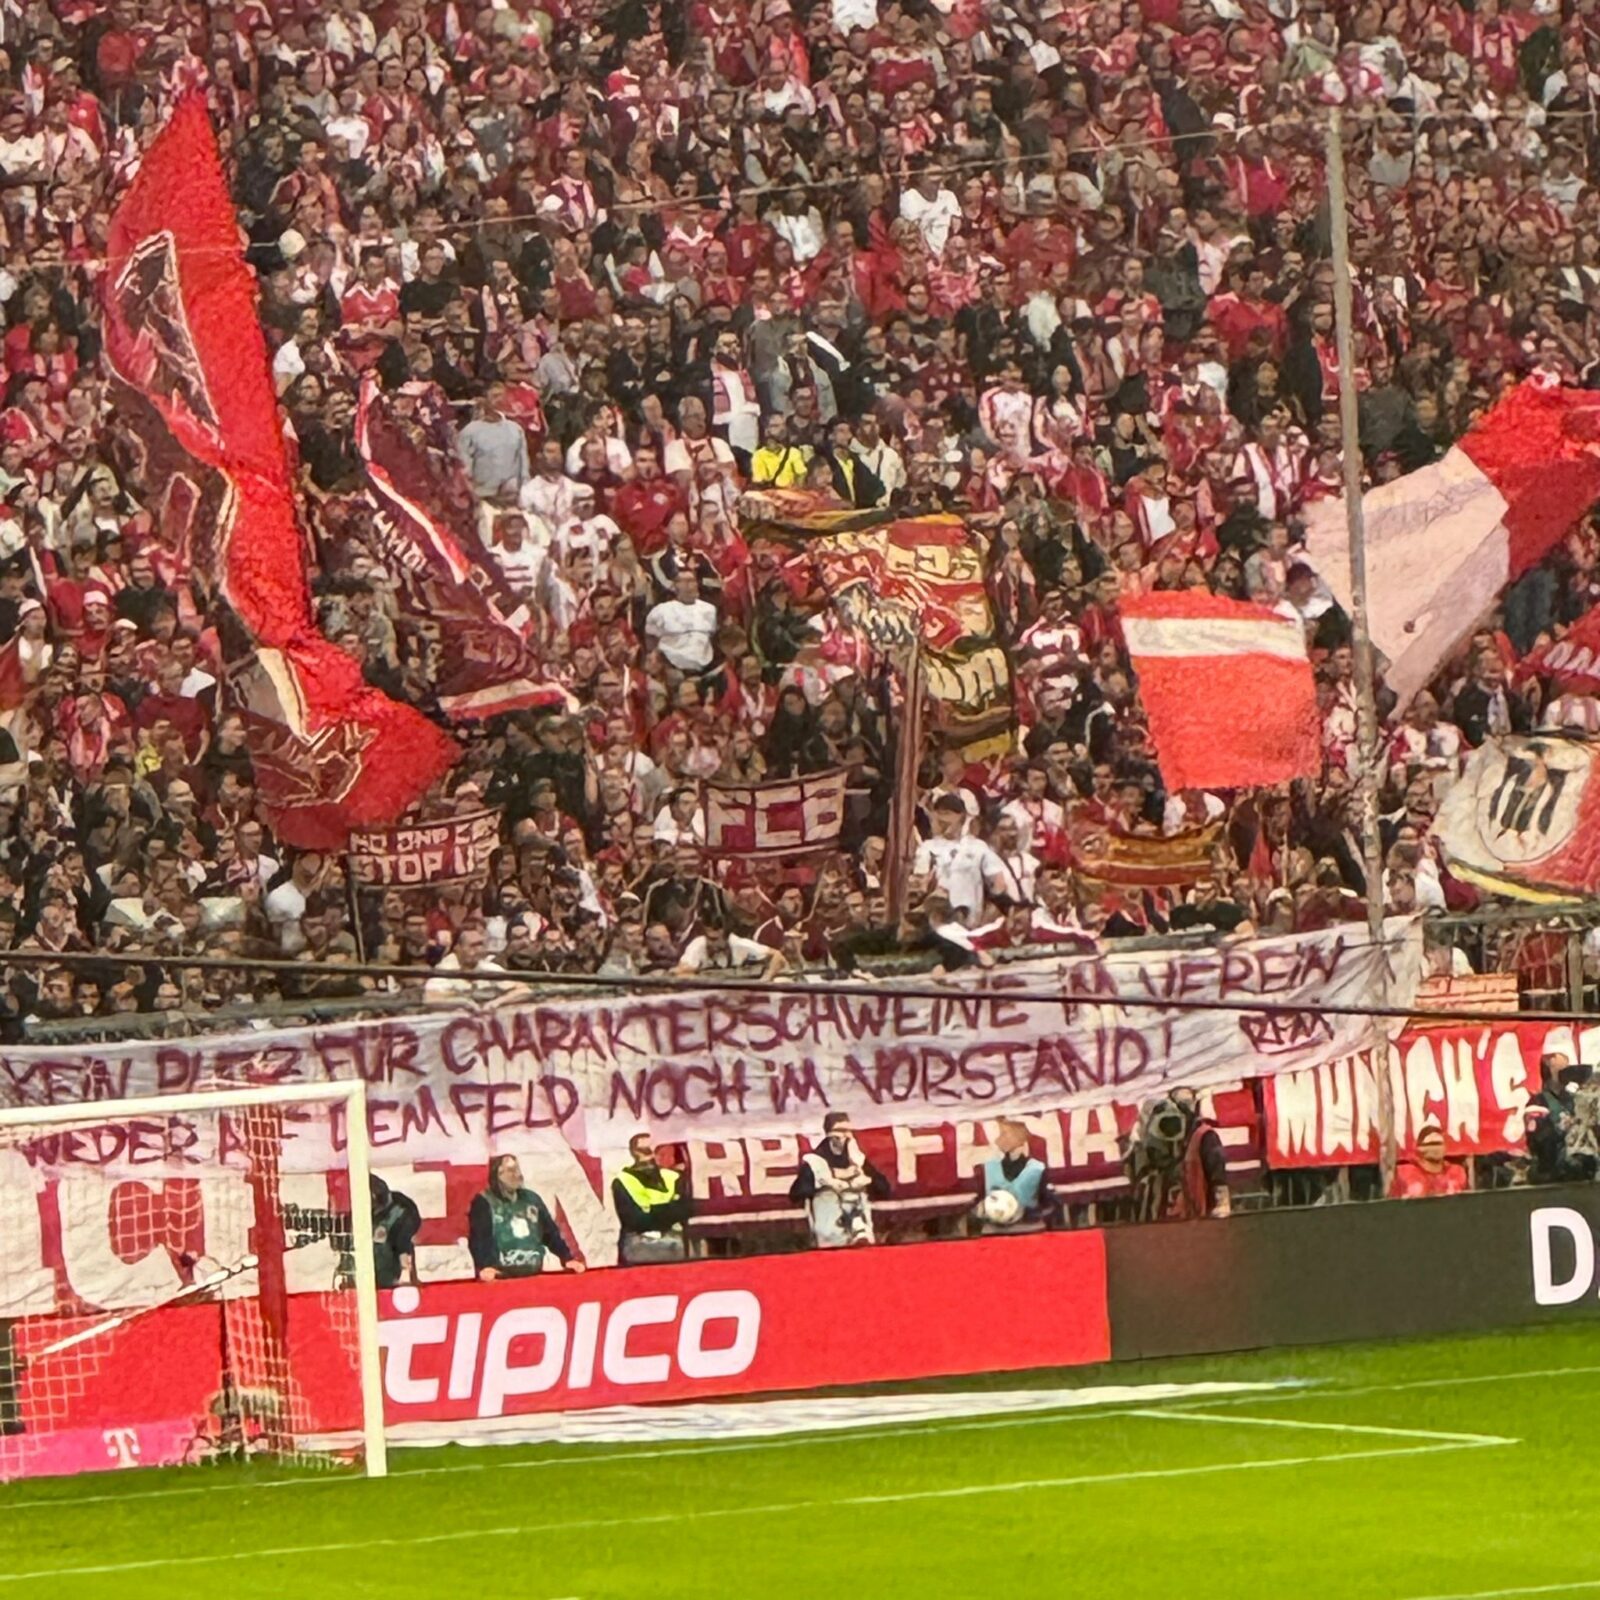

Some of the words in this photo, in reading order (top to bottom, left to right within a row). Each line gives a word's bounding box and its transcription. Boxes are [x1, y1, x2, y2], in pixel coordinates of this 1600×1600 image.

[707, 772, 847, 847] FCB
[349, 850, 444, 884] STOP
[450, 1074, 579, 1136] FELD
[608, 1058, 750, 1120] NOCH
[1274, 1028, 1530, 1158] MUNICH'S
[378, 1286, 761, 1417] tipico
[102, 1427, 141, 1469] T
